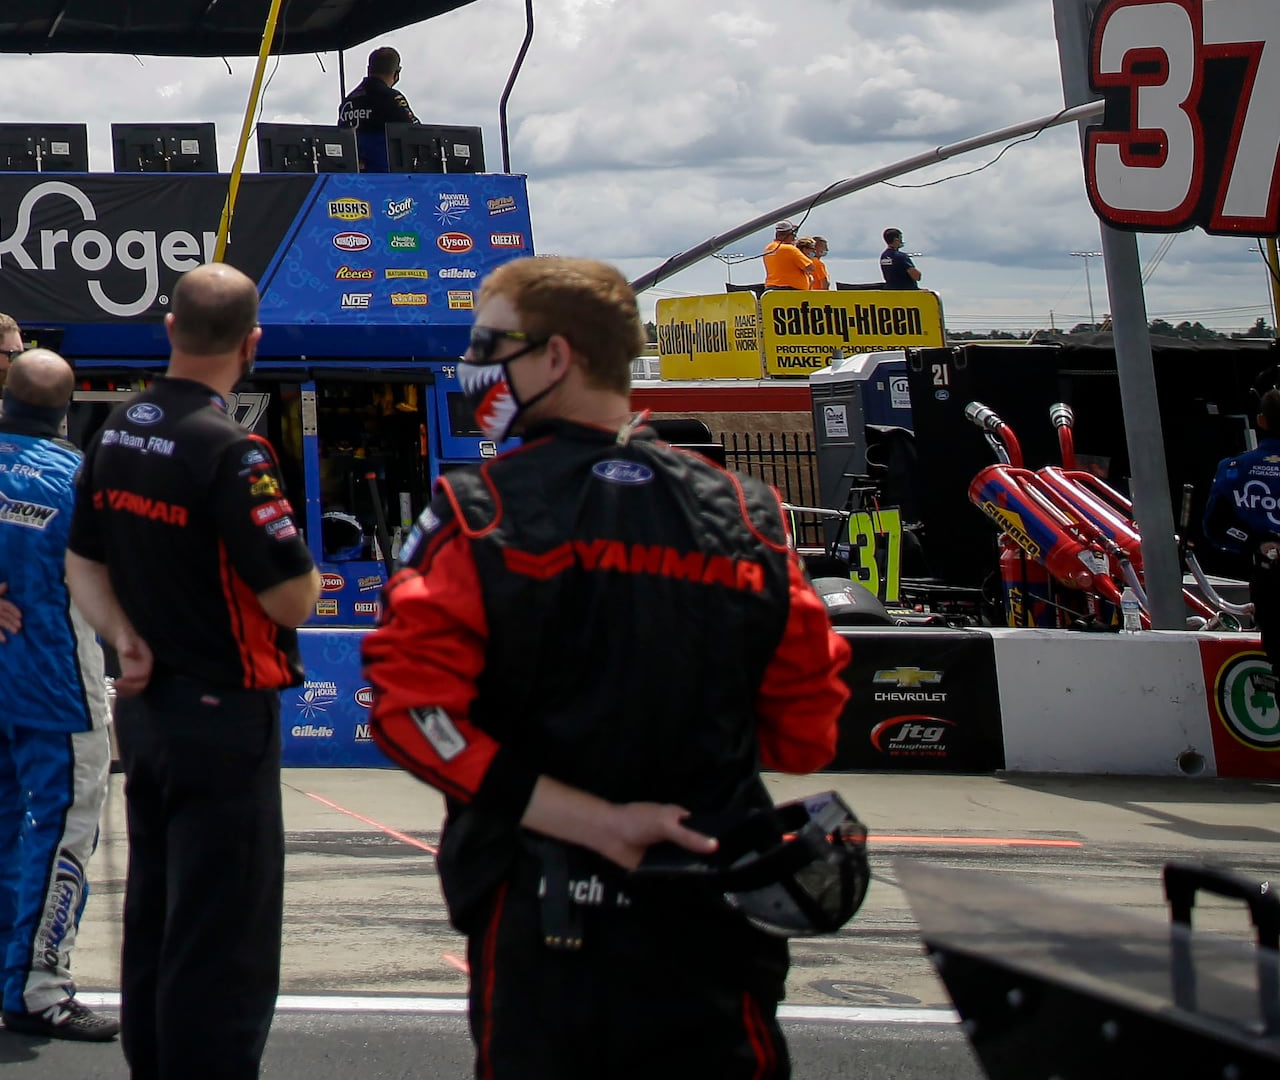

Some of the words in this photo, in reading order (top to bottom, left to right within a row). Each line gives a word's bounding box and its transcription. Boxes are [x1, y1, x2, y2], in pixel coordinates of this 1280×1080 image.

[330, 202, 369, 215] BUSH'S
[387, 198, 413, 216] Scott
[390, 240, 416, 248] Choice
[442, 236, 471, 249] Tyson
[439, 268, 476, 278] Gillette
[342, 293, 372, 306] NOS
[734, 315, 756, 327] MAKE
[734, 328, 756, 339] GREEN
[736, 340, 758, 351] WORK
[777, 356, 818, 368] MAKE
[932, 363, 949, 385] 21
[131, 405, 158, 421] Ford
[603, 462, 643, 480] Ford
[1233, 480, 1280, 525] Kro
[983, 500, 1041, 557] SUNOCO
[849, 508, 901, 602] 37
[572, 538, 764, 593] YANMAR
[321, 577, 342, 588] yson
[303, 681, 337, 689] MAXWELL
[314, 688, 337, 696] HOUSE
[875, 692, 947, 701] CHEVROLET
[291, 725, 335, 737] Gillette
[890, 723, 945, 742] jtg
[888, 742, 946, 751] Daugherty
